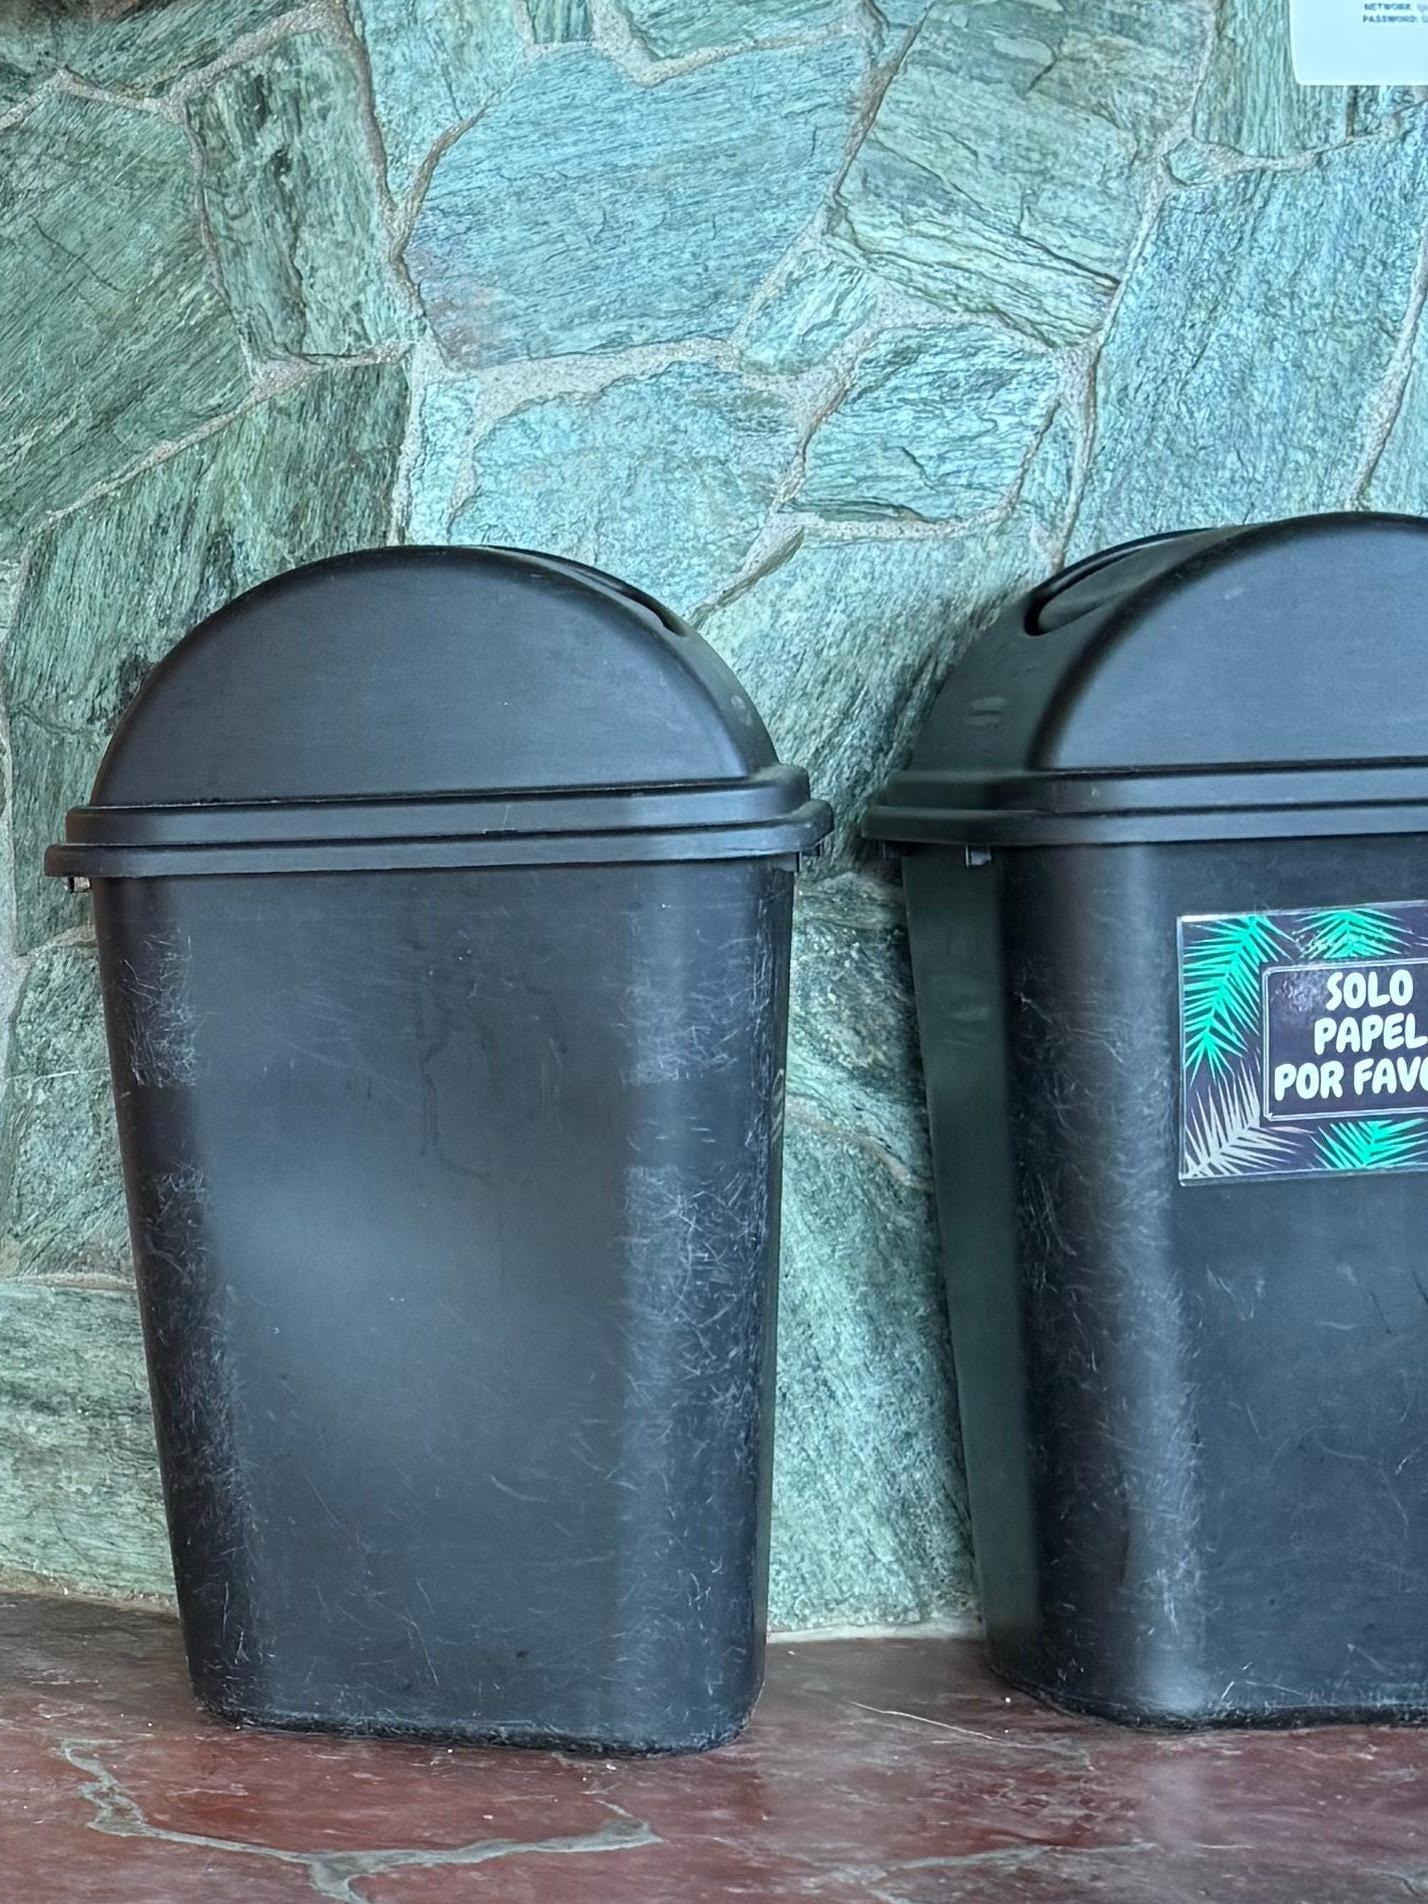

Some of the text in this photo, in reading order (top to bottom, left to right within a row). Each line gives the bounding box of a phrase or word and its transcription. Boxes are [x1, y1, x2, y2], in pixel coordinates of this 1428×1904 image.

[1325, 969, 1413, 1011] SOLO
[1314, 1012, 1428, 1055] PAPEL
[1274, 1060, 1344, 1101] POR
